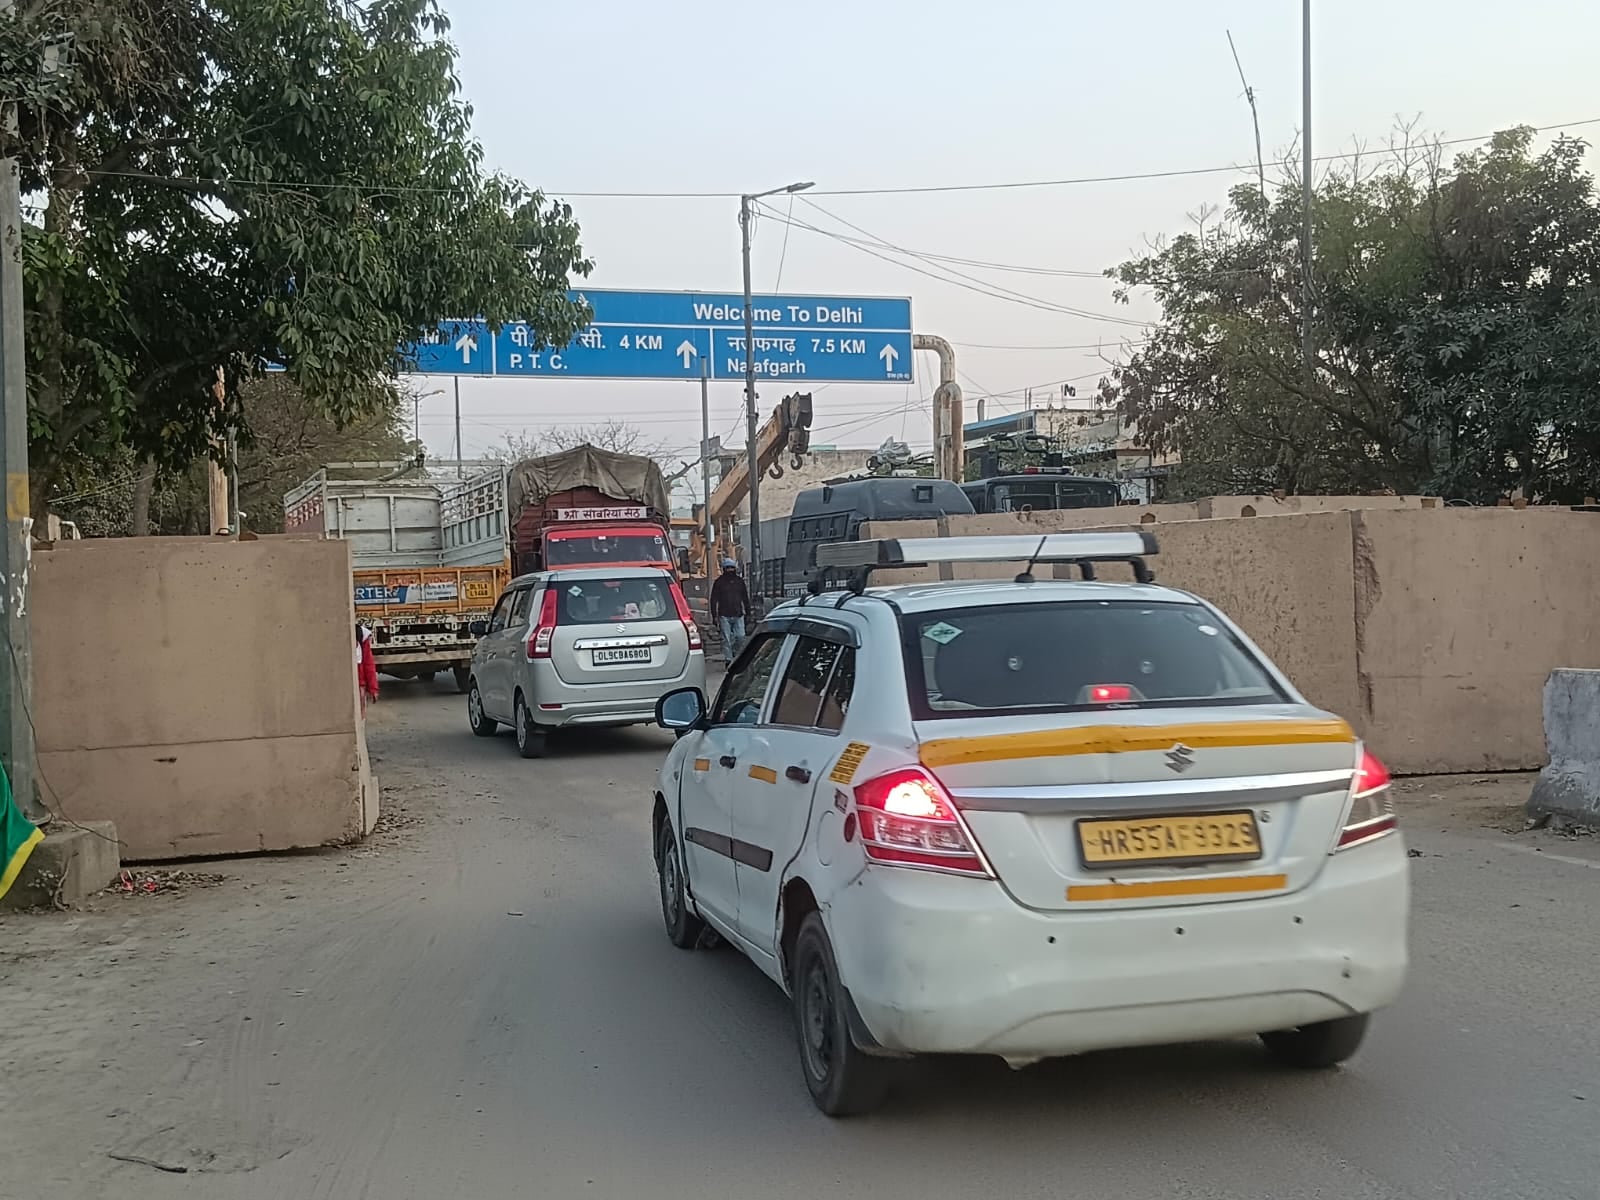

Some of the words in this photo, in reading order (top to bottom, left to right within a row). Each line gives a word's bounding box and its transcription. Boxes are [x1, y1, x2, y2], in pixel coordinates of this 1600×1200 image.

[787, 306, 810, 322] To
[816, 306, 863, 324] Delhi
[619, 335, 630, 349] 4
[635, 335, 663, 350] KM
[811, 339, 835, 353] 7.5
[840, 339, 866, 354] KM
[510, 353, 523, 369] P.
[528, 354, 542, 369] T.
[549, 354, 568, 370] C.
[727, 358, 806, 377] Naafgarh
[1099, 821, 1255, 856] HR55AF9329
